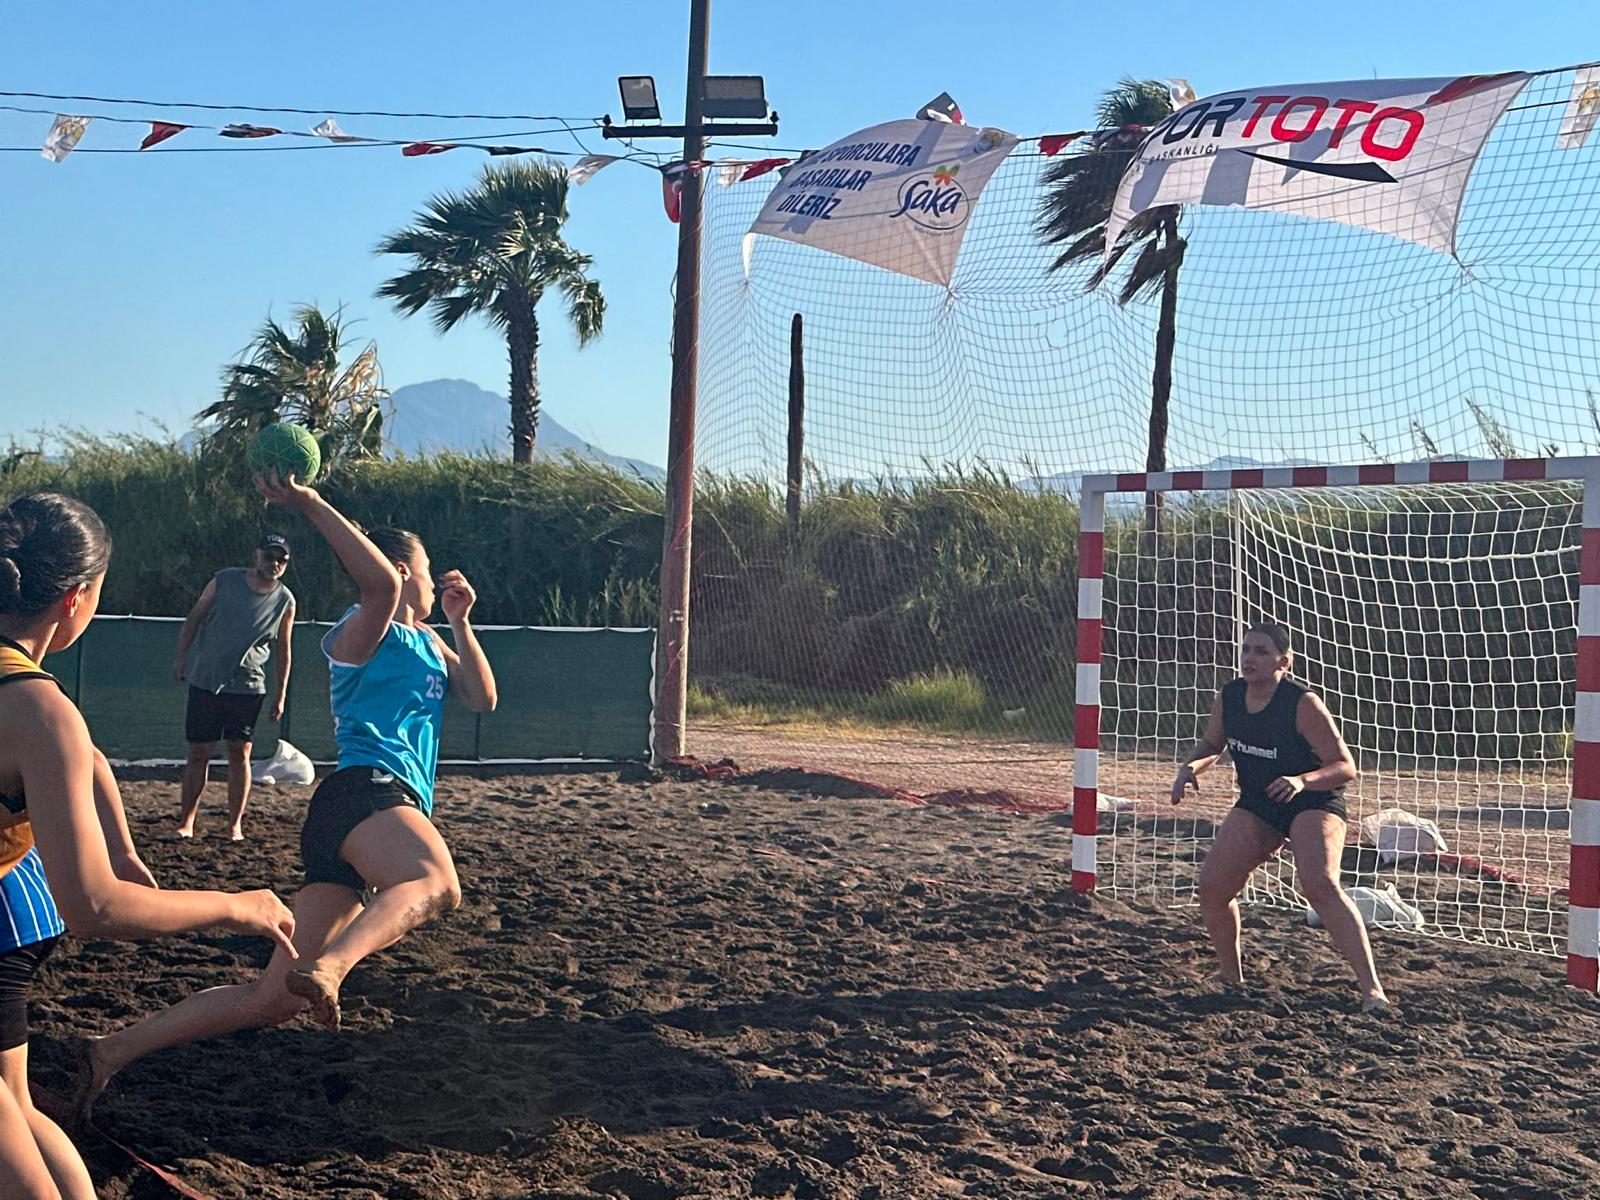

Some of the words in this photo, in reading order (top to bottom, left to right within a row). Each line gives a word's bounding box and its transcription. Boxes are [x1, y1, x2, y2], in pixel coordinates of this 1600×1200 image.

[776, 191, 842, 220] DİLERİZ
[889, 180, 962, 218] Saka
[425, 674, 444, 700] 25
[1236, 740, 1278, 759] hummel
